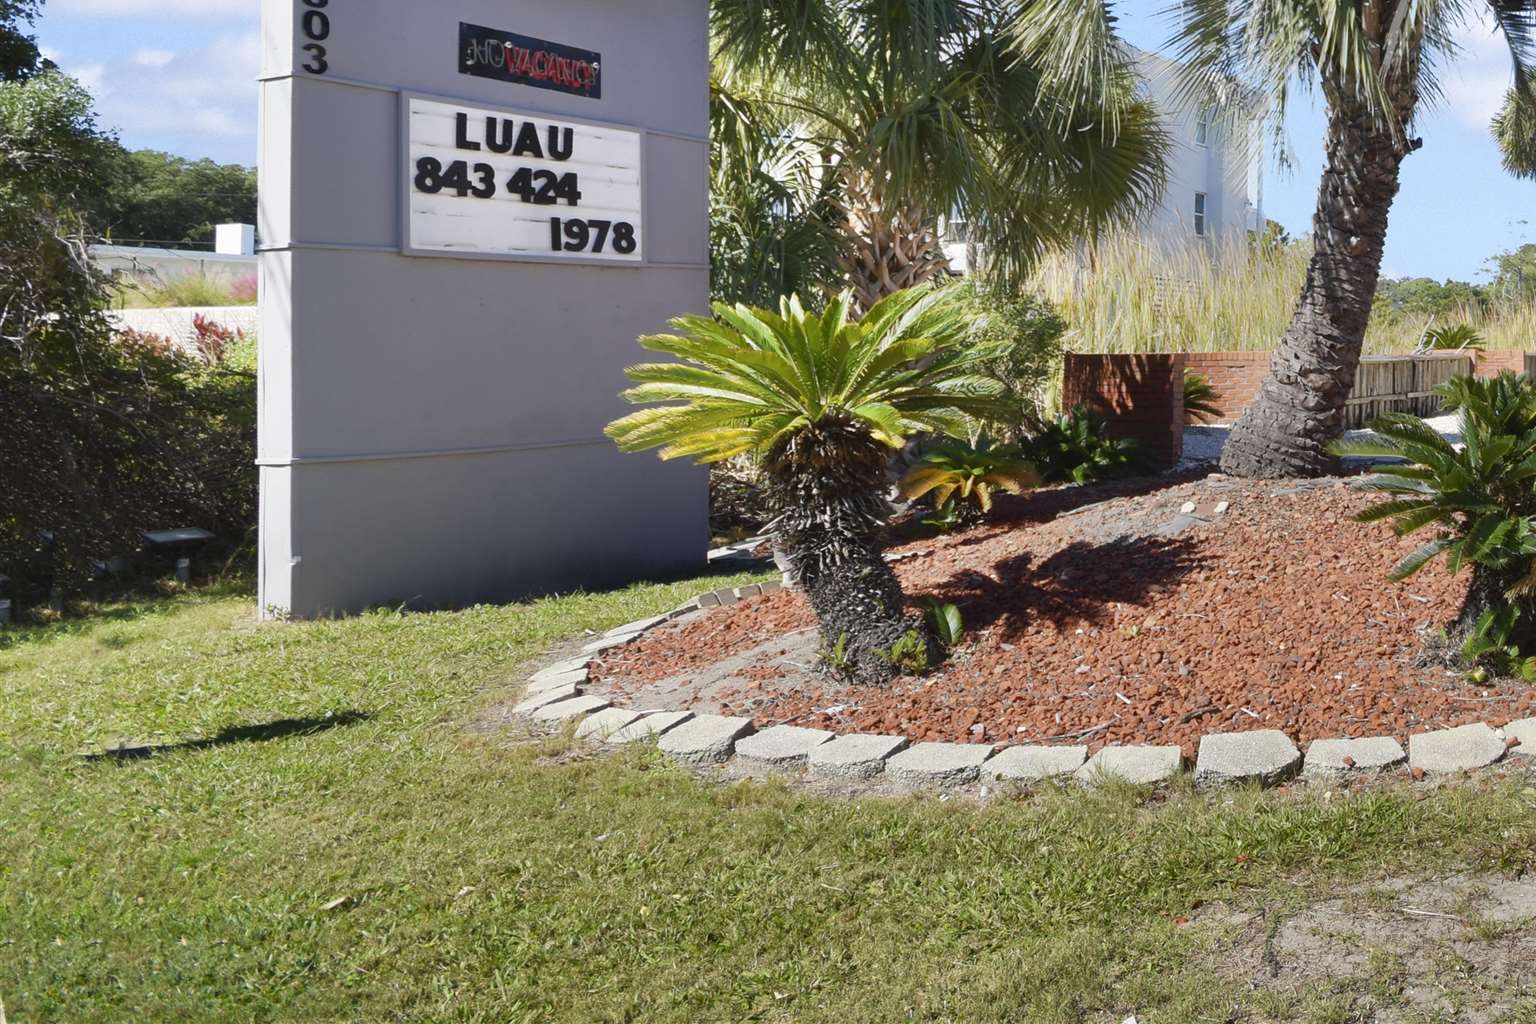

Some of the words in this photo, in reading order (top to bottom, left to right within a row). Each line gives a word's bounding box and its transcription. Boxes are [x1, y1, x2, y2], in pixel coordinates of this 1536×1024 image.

[455, 112, 573, 161] LUAU
[414, 157, 496, 199] 843
[506, 166, 582, 207] 424
[550, 216, 637, 254] 1978
